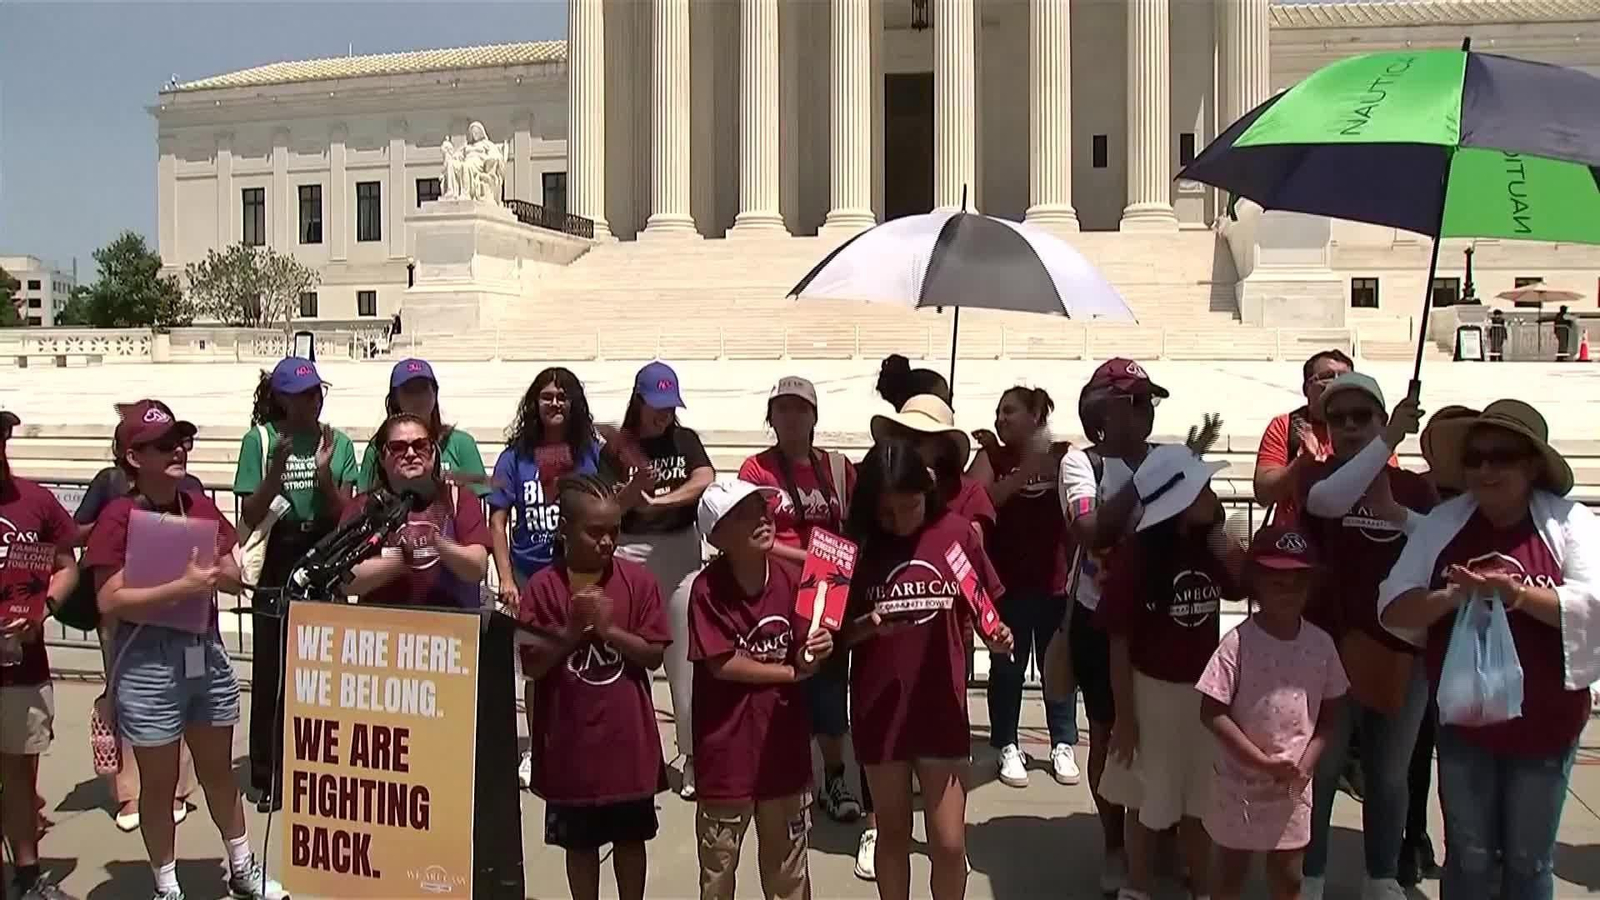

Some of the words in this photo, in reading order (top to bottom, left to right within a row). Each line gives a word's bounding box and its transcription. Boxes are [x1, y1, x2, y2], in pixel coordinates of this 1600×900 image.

[525, 506, 560, 531] RIG
[890, 581, 926, 597] ARE
[297, 625, 334, 663] WE
[341, 628, 389, 668] ARE
[397, 633, 470, 675] HERE.
[567, 640, 622, 672] CAS
[295, 667, 332, 707] WE
[340, 672, 445, 718] BELONG.
[293, 716, 340, 765] WE
[350, 722, 410, 774] ARE
[292, 770, 430, 831] FIGHTING
[291, 823, 381, 879] BACK.
